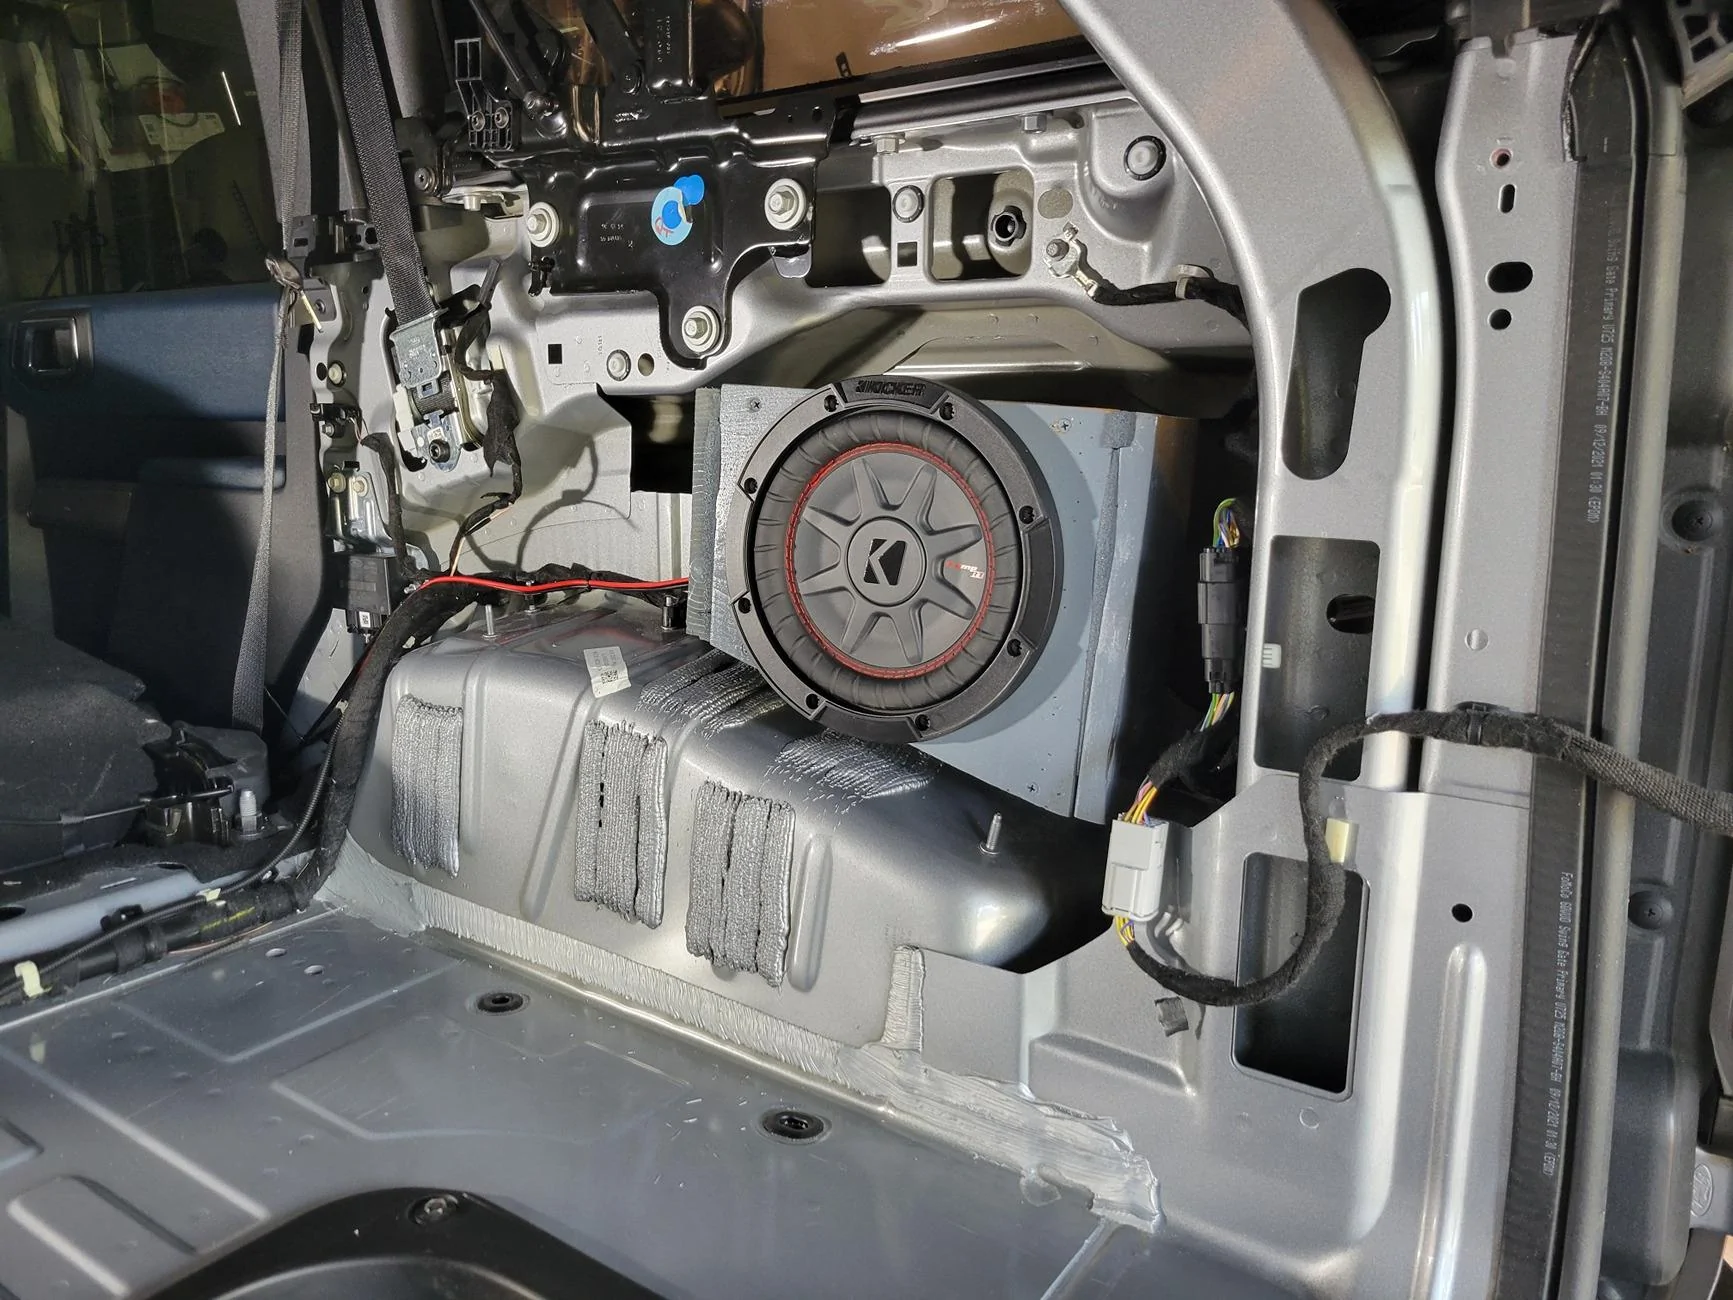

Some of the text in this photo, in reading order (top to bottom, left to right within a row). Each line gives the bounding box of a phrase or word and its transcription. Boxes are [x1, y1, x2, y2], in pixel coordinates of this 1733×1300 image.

[1602, 288, 1619, 321] Primary
[1591, 424, 1607, 468] 09/12/2021
[1589, 471, 1603, 493] 01:30
[1559, 871, 1574, 899] FoMoCo
